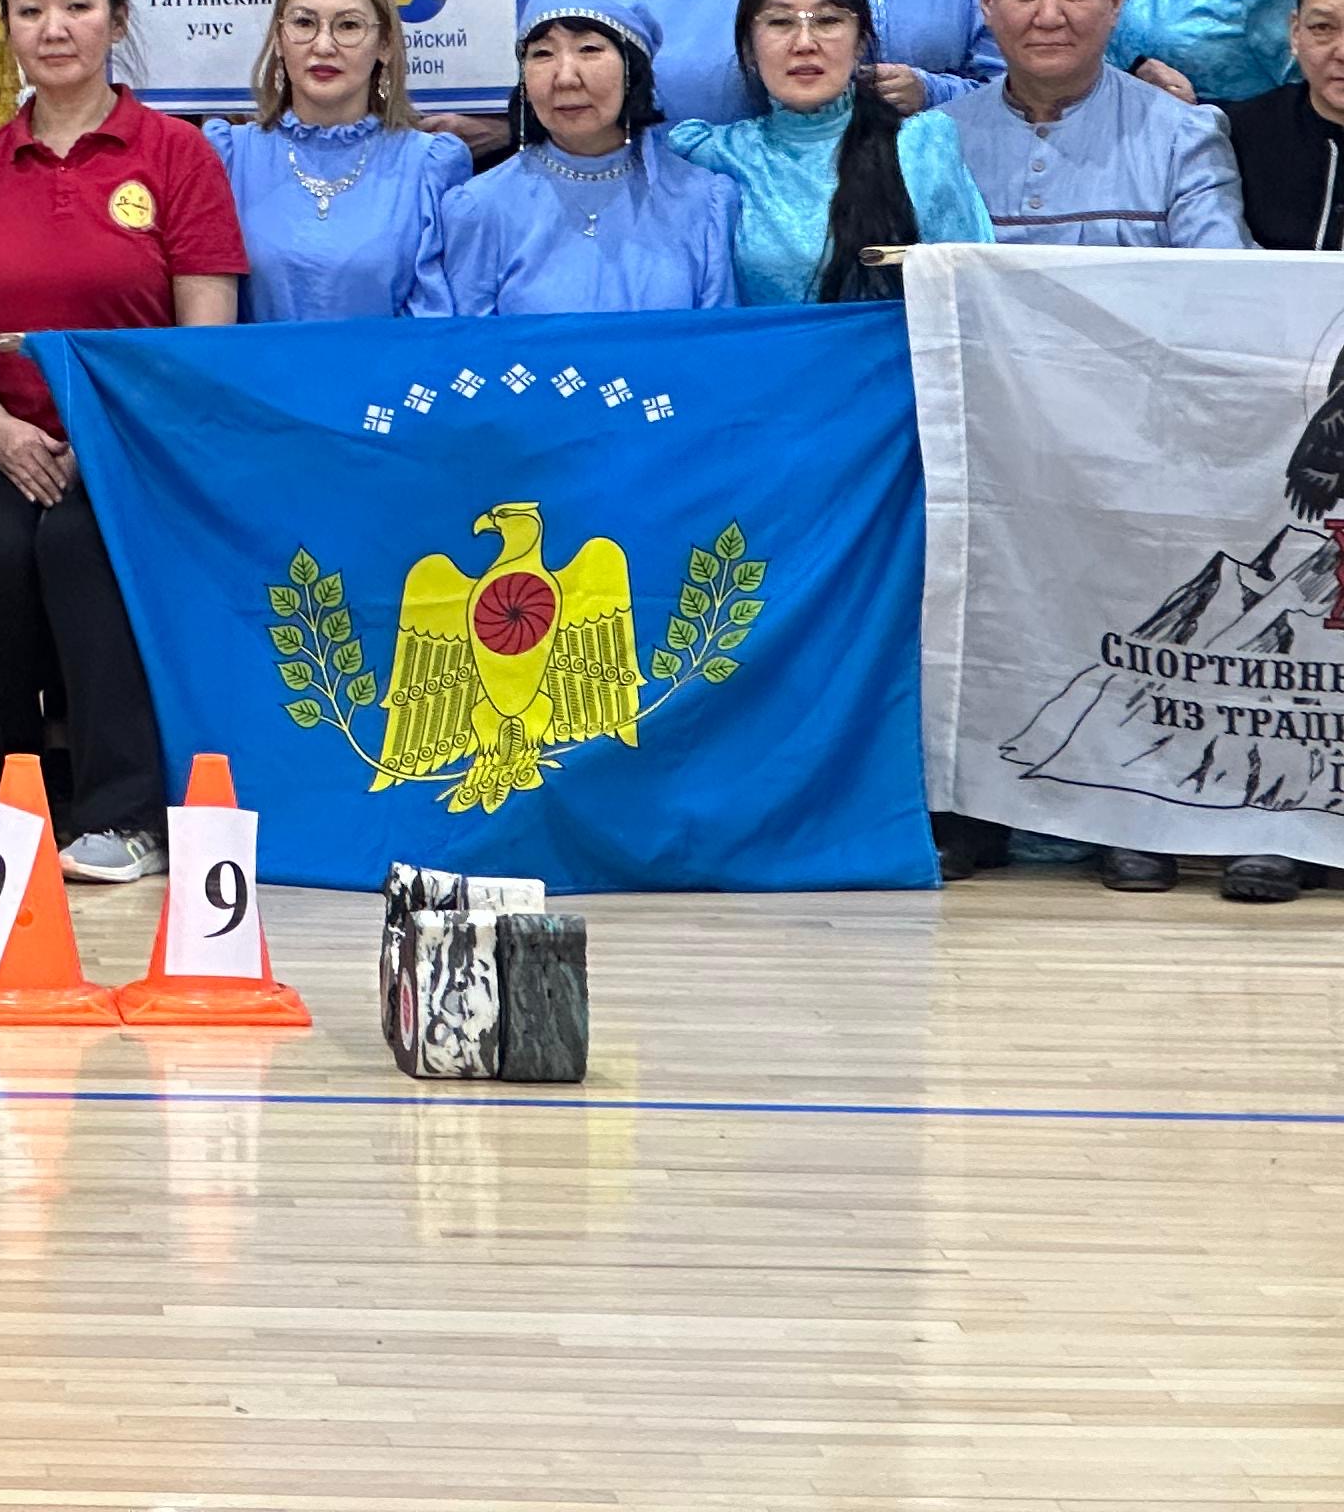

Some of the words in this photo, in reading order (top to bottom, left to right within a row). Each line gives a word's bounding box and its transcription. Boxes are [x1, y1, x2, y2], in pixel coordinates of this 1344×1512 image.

[186, 21, 234, 41] улус
[404, 28, 467, 49] йский
[406, 55, 444, 75] йон
[1151, 694, 1206, 731] ИЗ
[203, 860, 248, 938] 9
